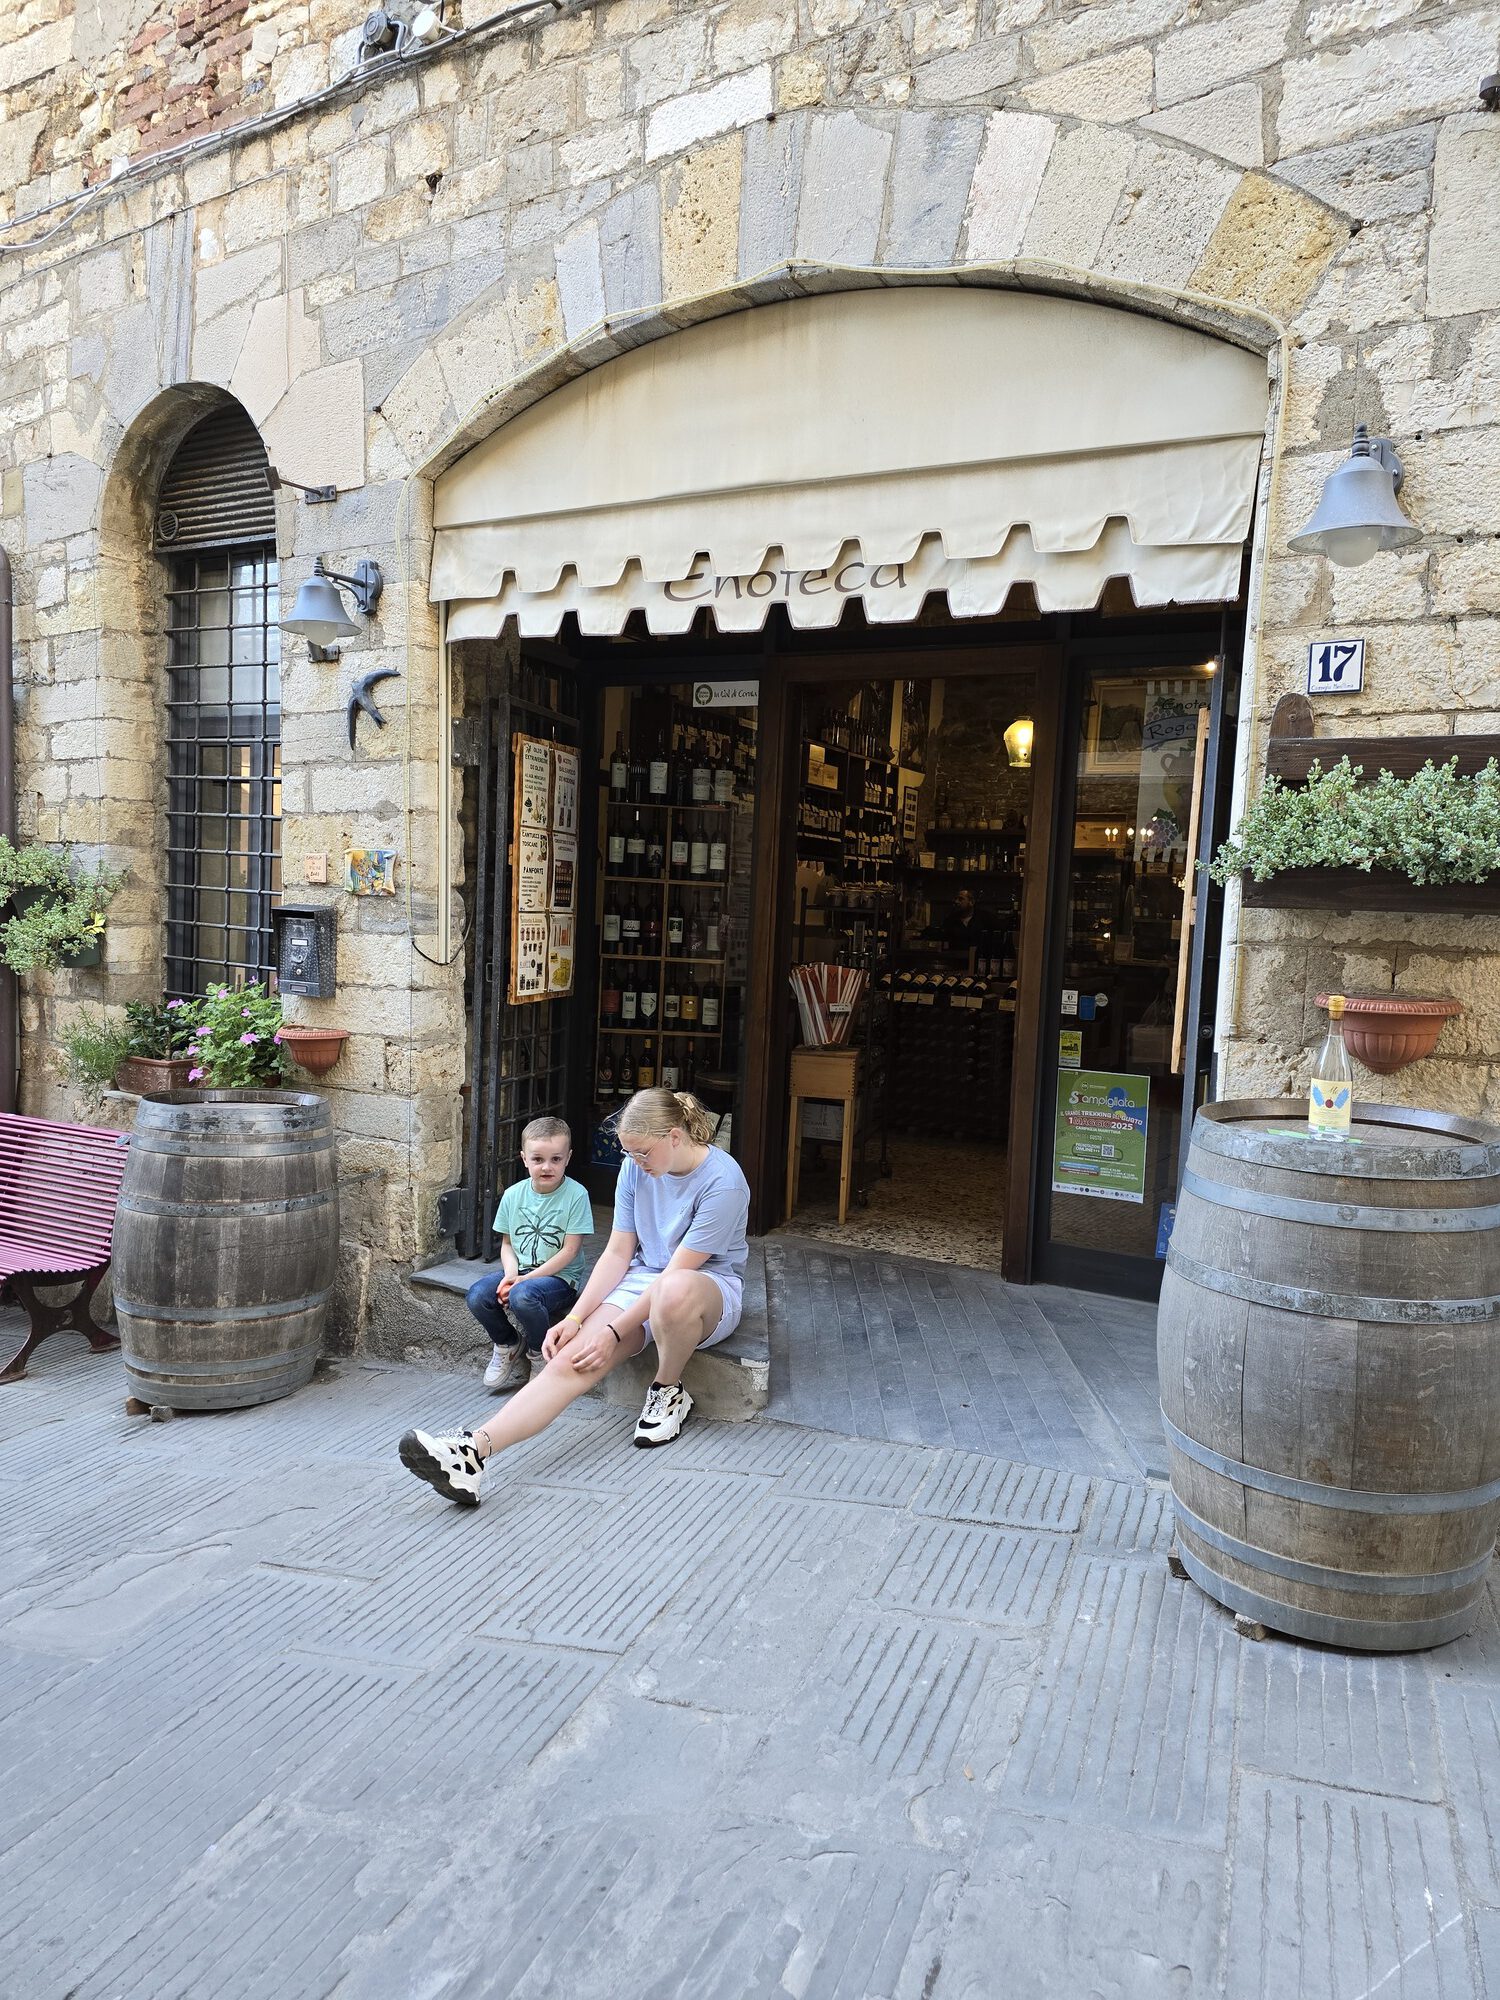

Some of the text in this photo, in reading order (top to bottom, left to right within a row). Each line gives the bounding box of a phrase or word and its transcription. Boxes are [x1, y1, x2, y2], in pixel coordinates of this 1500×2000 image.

[663, 562, 907, 602] Enoteca
[1318, 644, 1357, 682] 17
[1111, 1122, 1134, 1130] 2025
